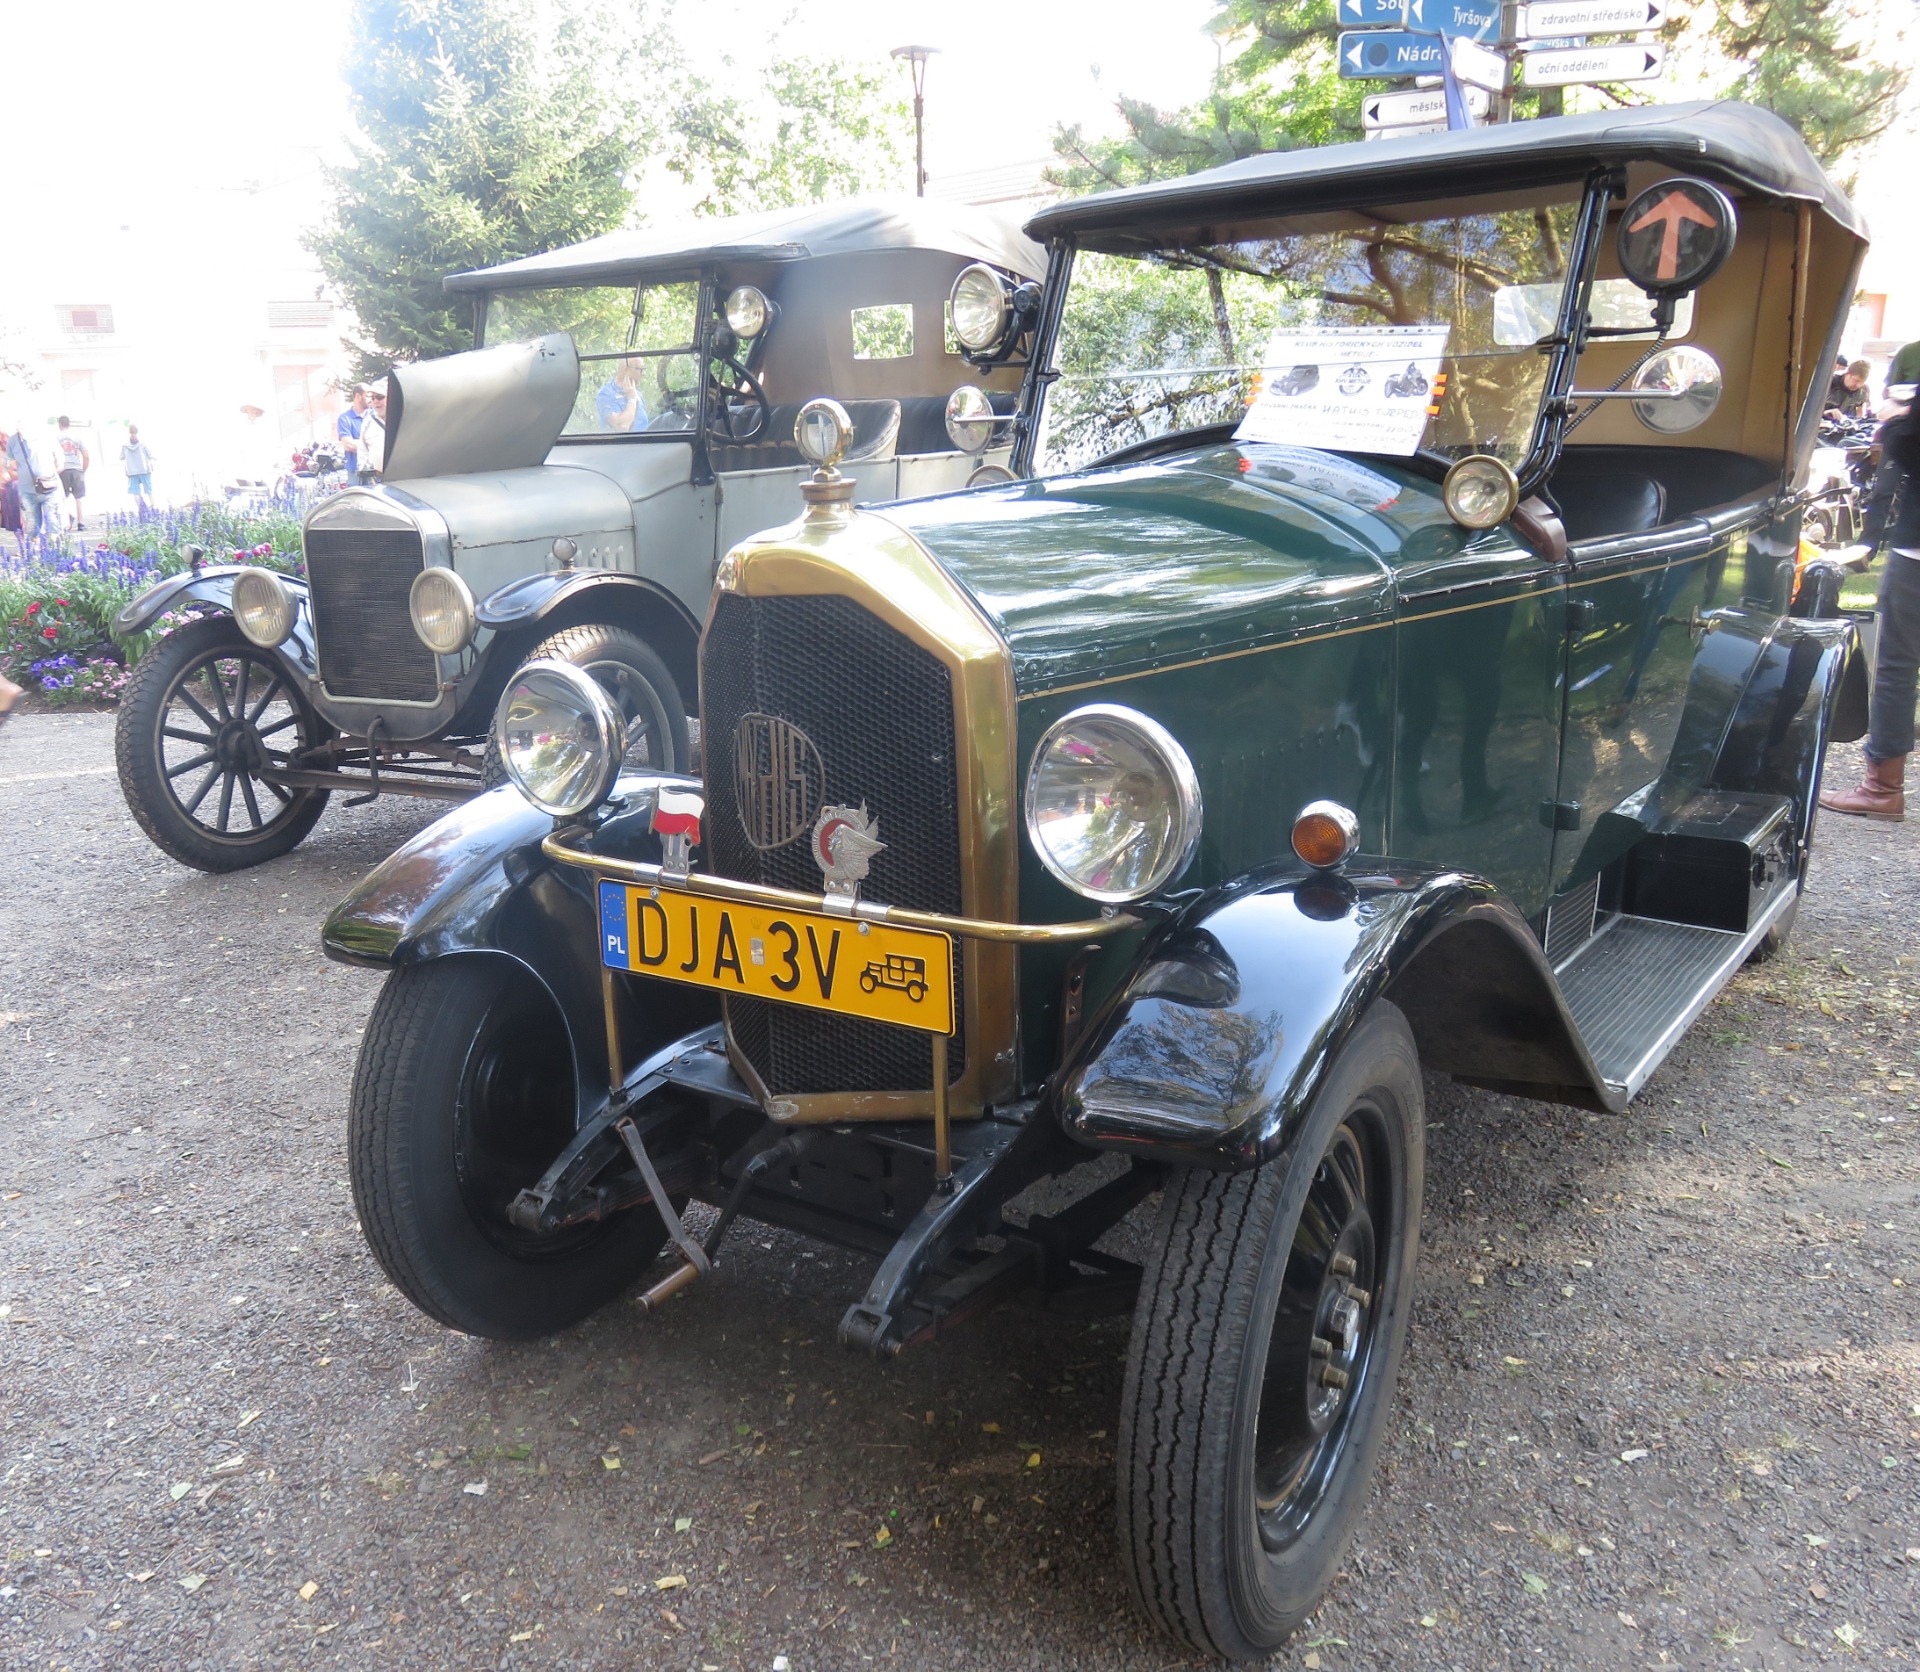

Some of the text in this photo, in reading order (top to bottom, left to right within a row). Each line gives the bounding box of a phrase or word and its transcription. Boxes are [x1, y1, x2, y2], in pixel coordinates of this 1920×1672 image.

[1453, 6, 1492, 27] Tyršova
[1541, 9, 1643, 25] zdravotní středisko
[1538, 59, 1608, 74] oční oddělení
[607, 934, 626, 955] PL
